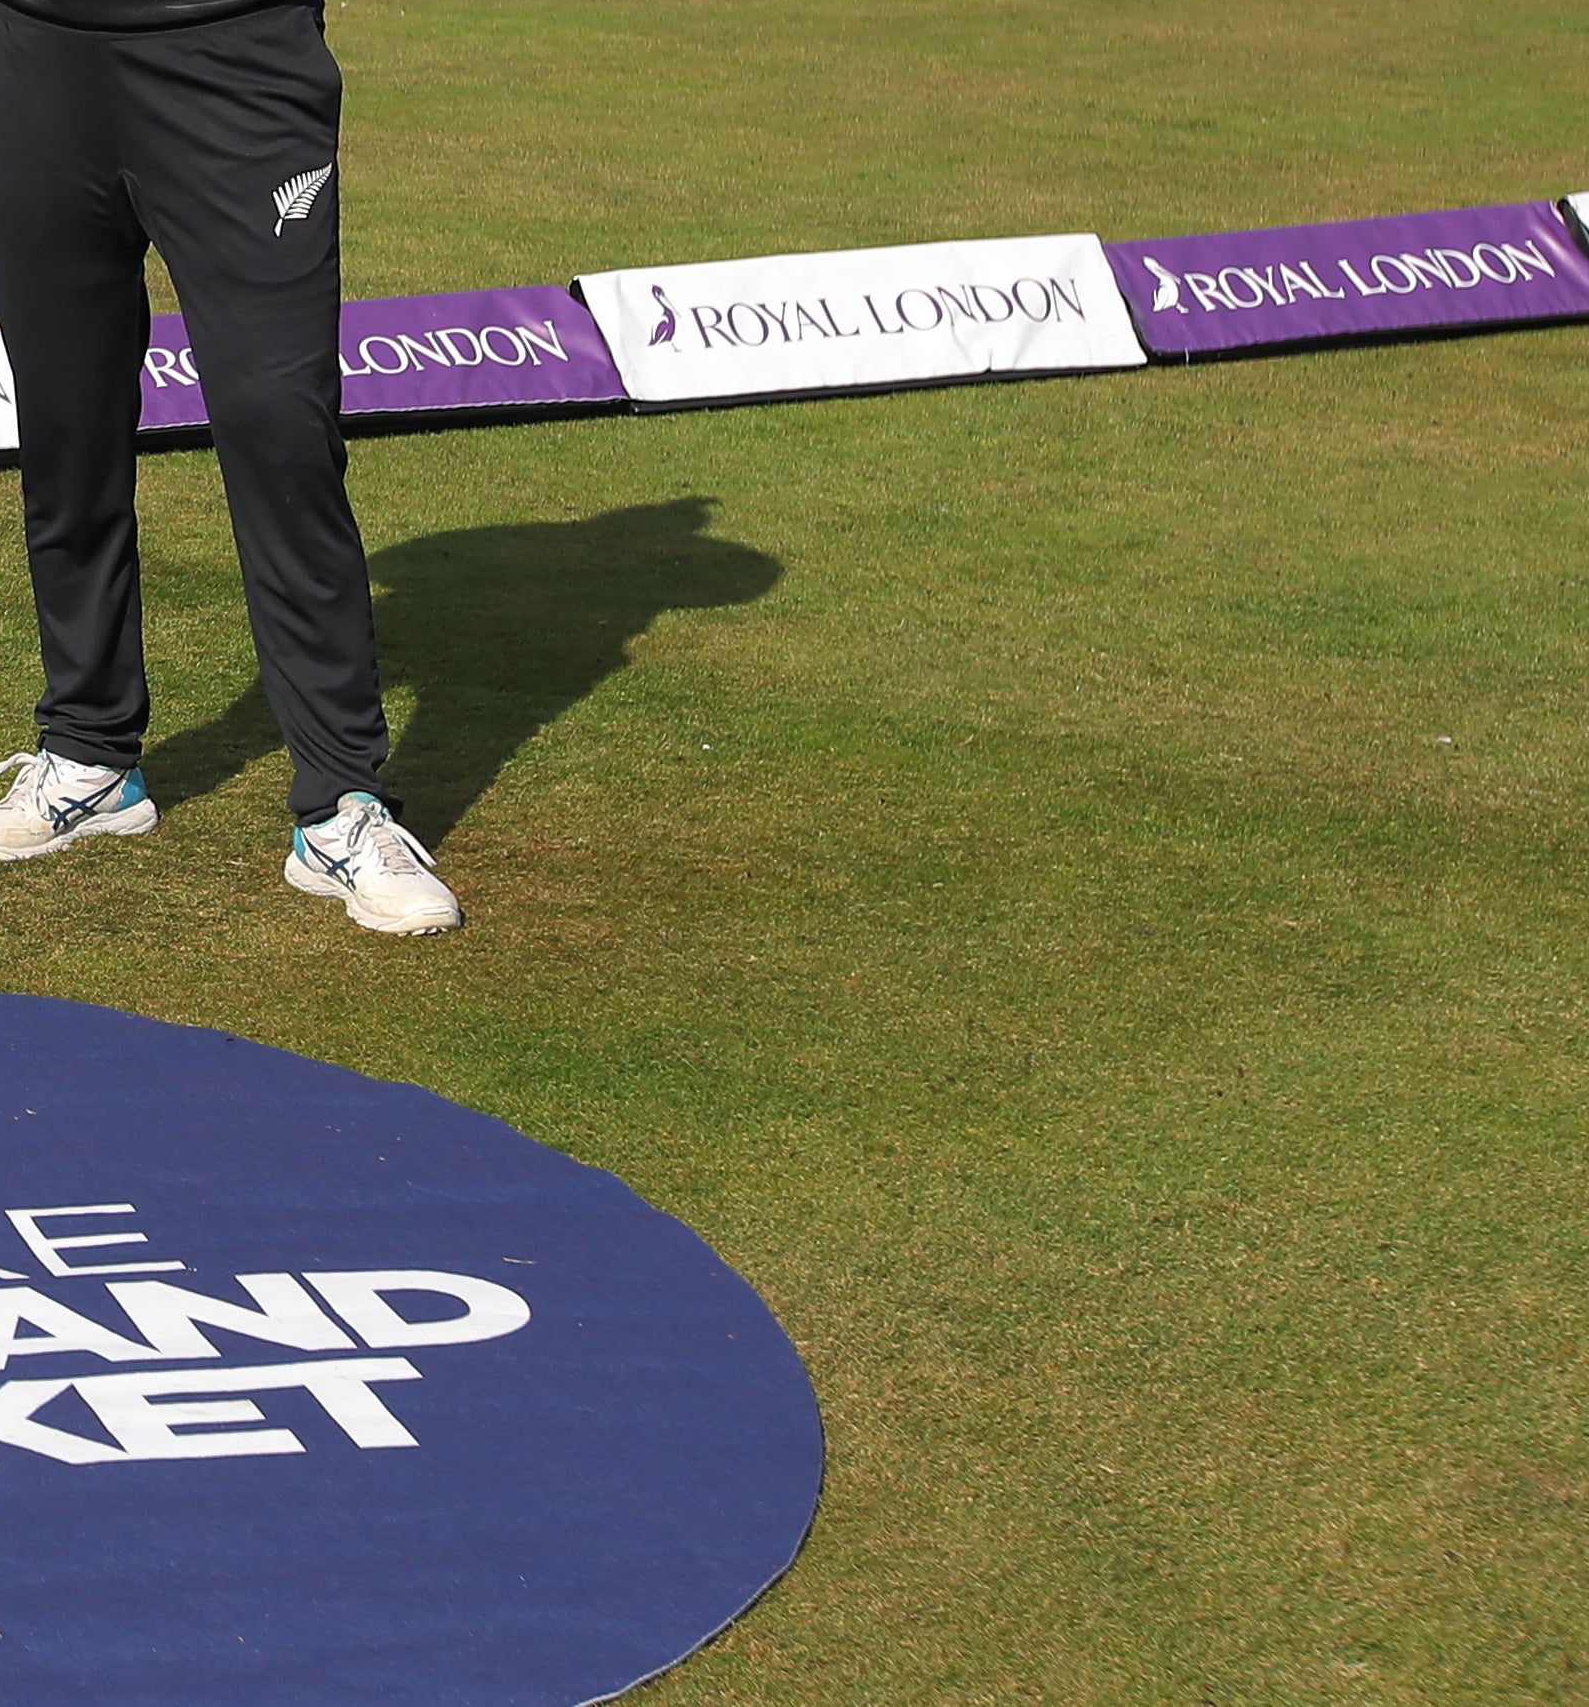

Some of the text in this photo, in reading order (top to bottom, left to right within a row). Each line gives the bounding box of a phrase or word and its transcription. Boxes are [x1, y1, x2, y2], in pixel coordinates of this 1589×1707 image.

[690, 276, 1088, 350] ROYAL LONDON
[1184, 239, 1556, 313] ROYAL LONDON
